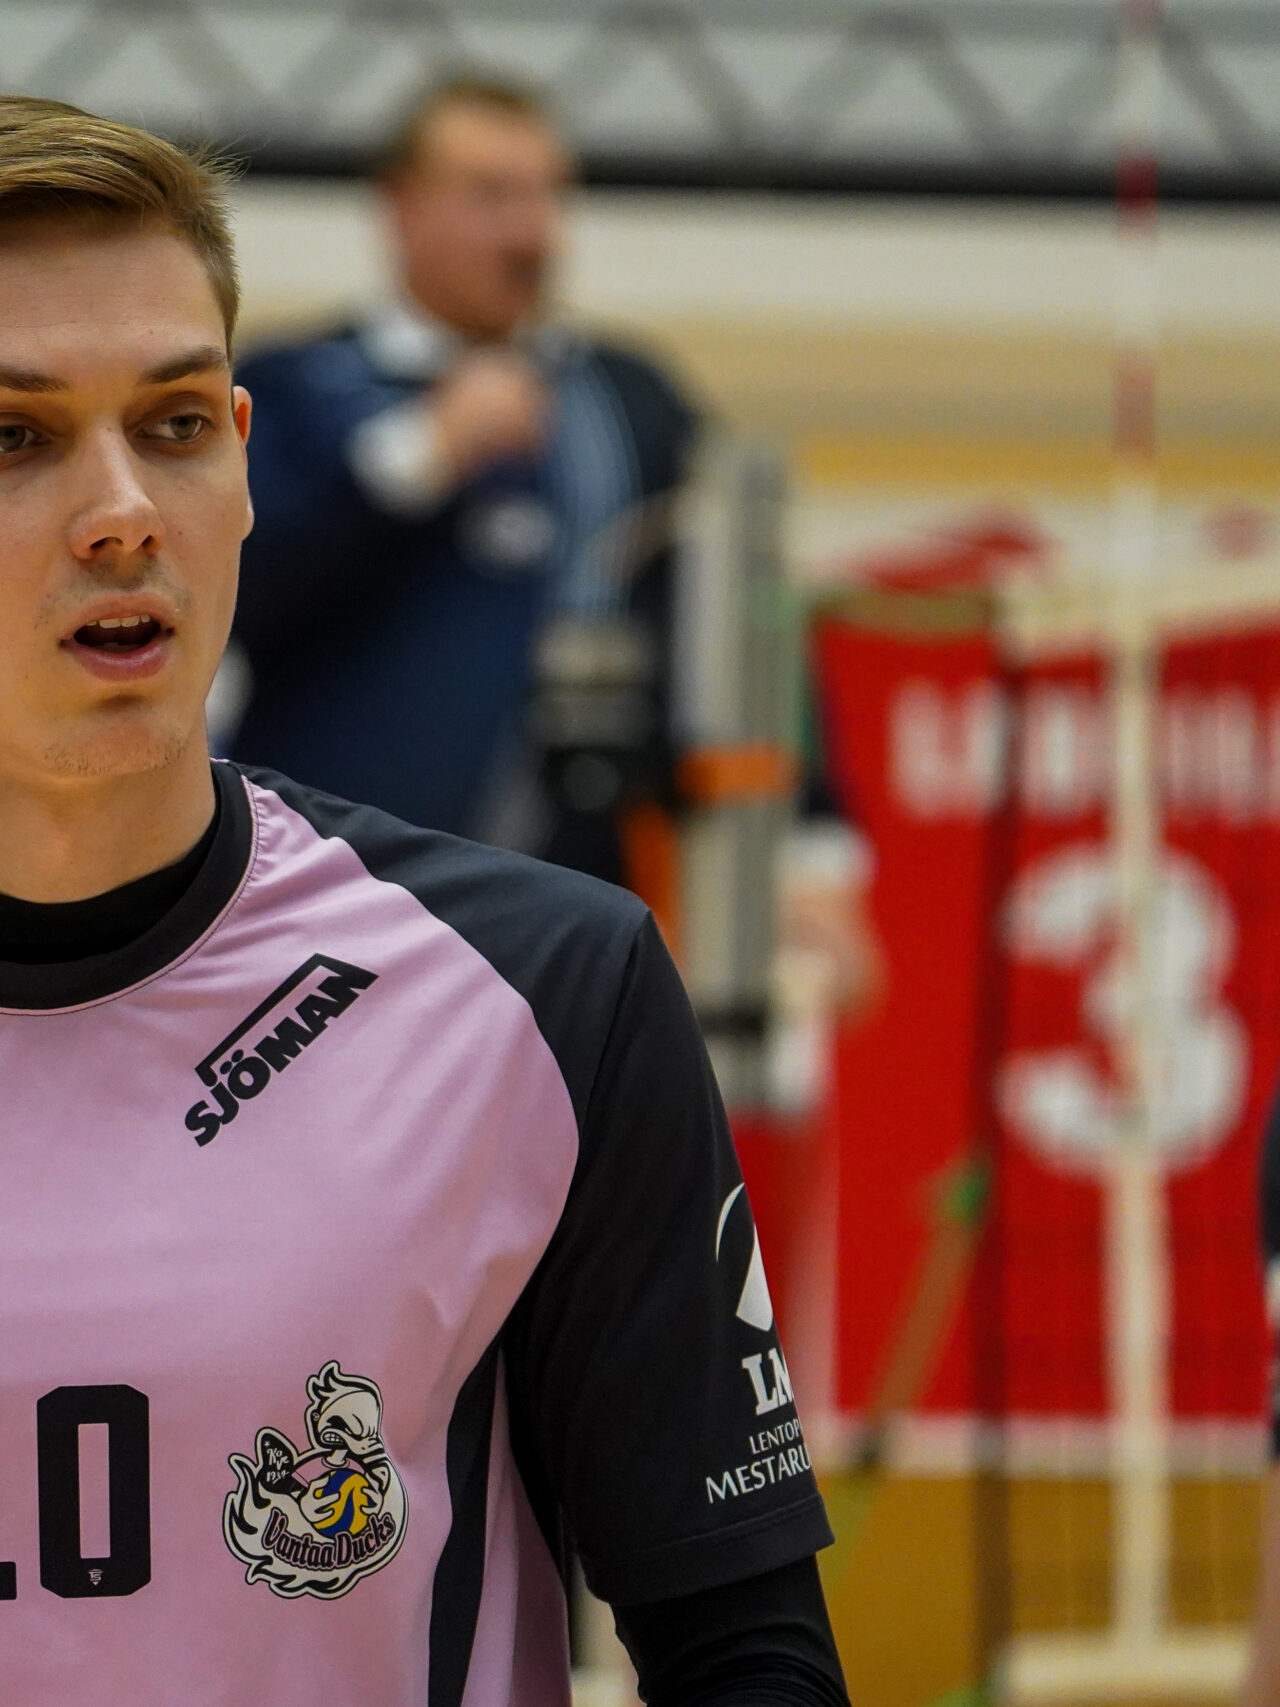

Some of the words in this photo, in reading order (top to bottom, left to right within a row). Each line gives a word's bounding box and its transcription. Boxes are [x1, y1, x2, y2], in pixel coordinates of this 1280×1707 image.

[184, 954, 379, 1147] SJÖMAN
[1000, 850, 1244, 1172] 3
[263, 1508, 336, 1570] Vantaa
[336, 1513, 395, 1566] Ducks
